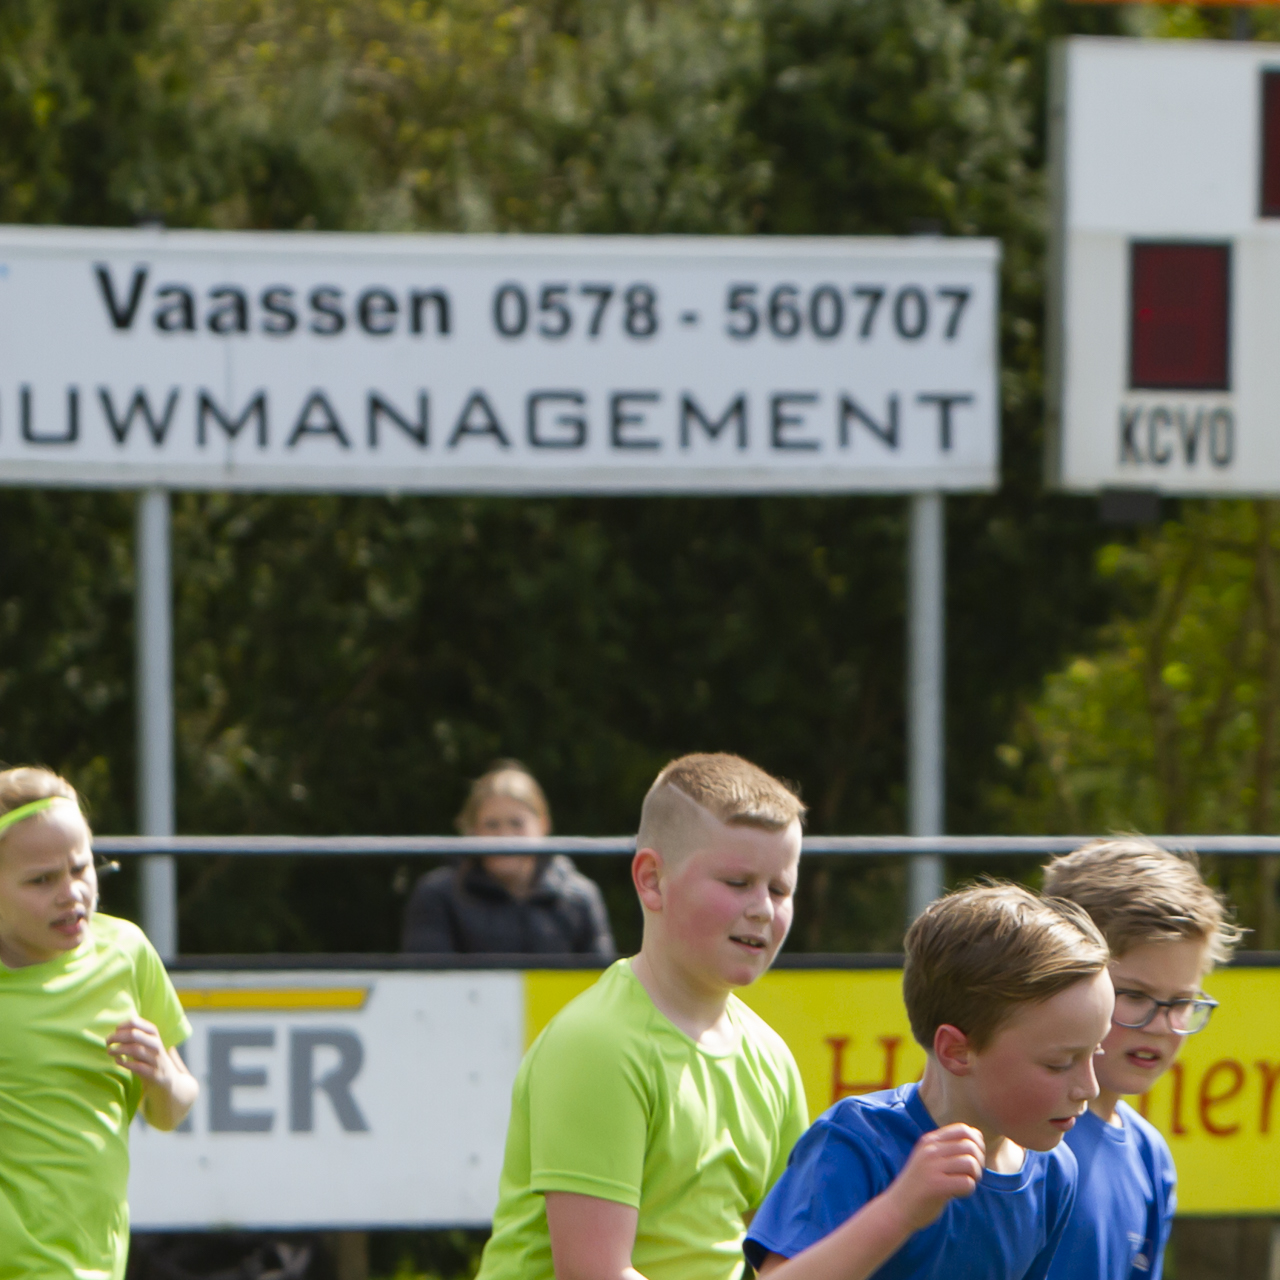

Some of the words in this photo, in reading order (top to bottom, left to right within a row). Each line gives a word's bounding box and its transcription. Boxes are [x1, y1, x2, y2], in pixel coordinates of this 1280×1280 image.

[94, 262, 452, 337] Vaassen
[493, 282, 659, 340] 0578
[725, 283, 974, 341] 560707
[18, 383, 976, 452] UWMANAGEMENT
[174, 1027, 371, 1133] ER
